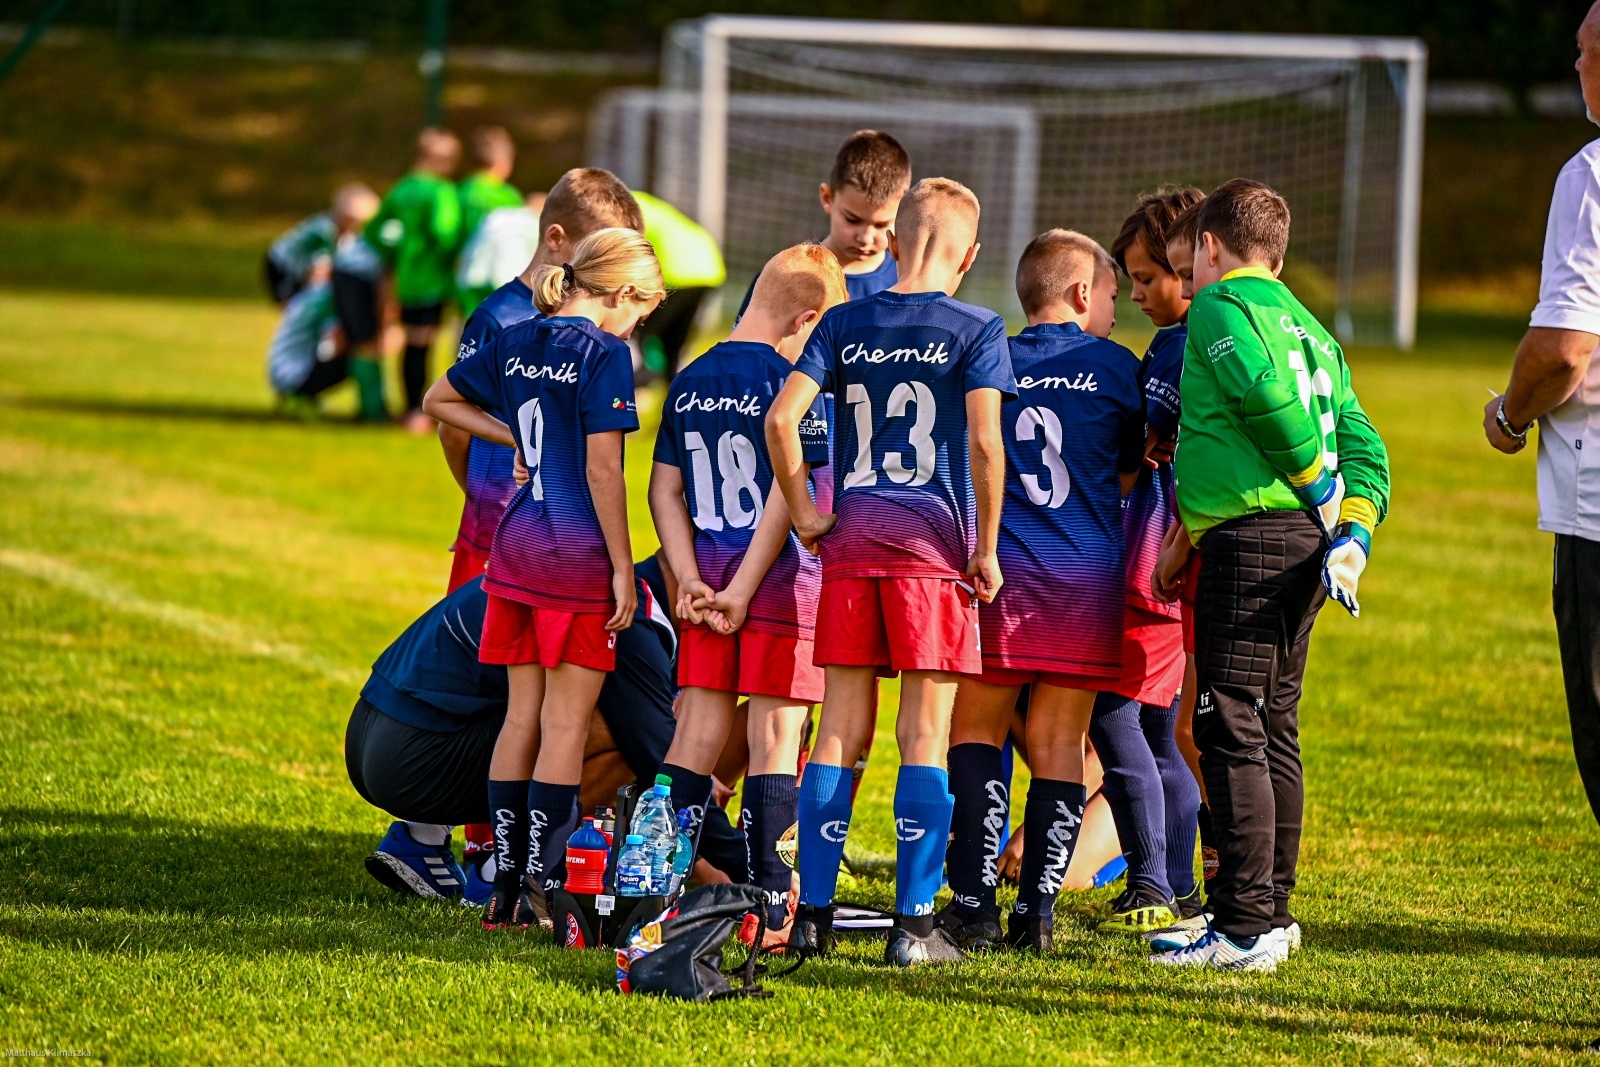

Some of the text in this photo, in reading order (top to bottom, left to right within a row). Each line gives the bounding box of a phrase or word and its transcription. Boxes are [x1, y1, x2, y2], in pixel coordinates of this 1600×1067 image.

[842, 343, 949, 365] Chemik
[1014, 373, 1098, 391] emik
[675, 391, 761, 416] Chemik
[843, 381, 937, 491] 13
[1015, 406, 1071, 509] 3
[684, 430, 764, 531] 18
[495, 808, 516, 872] Chemik
[526, 809, 548, 874] Chemik
